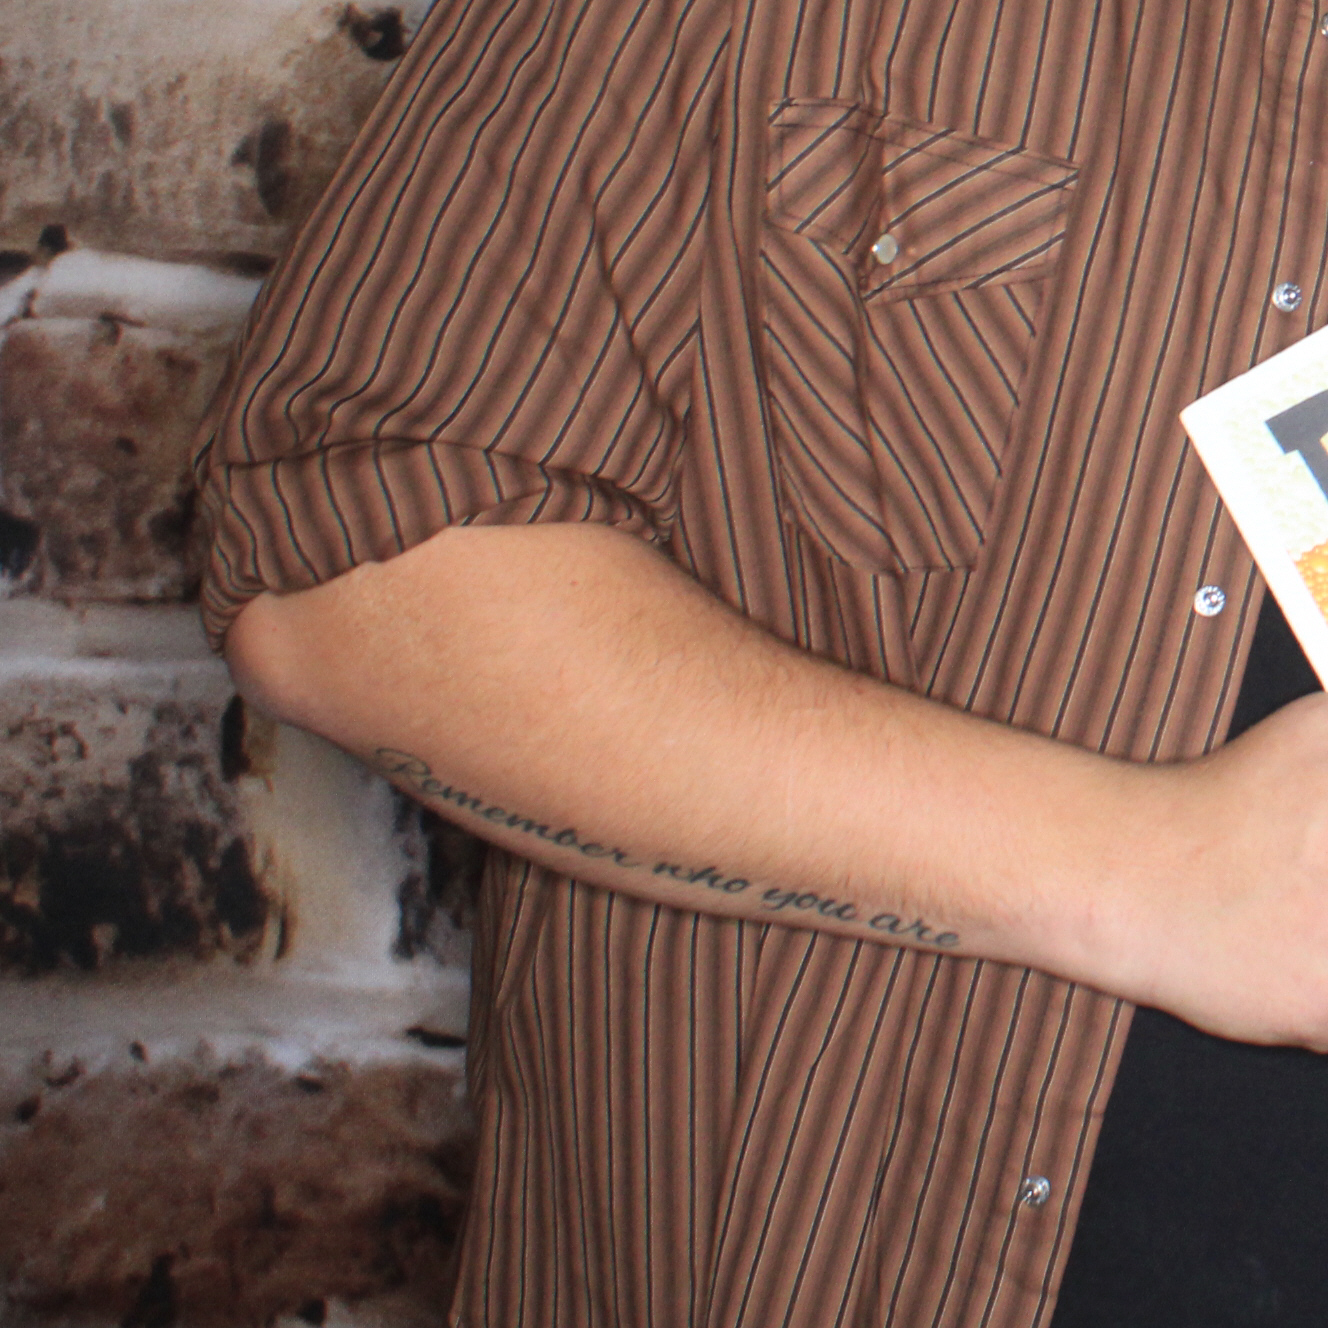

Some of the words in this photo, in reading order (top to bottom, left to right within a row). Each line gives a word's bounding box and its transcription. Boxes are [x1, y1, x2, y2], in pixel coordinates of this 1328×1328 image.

[374, 746, 641, 869] Remember
[652, 856, 748, 896] who
[761, 878, 860, 922] you
[868, 909, 961, 947] are
